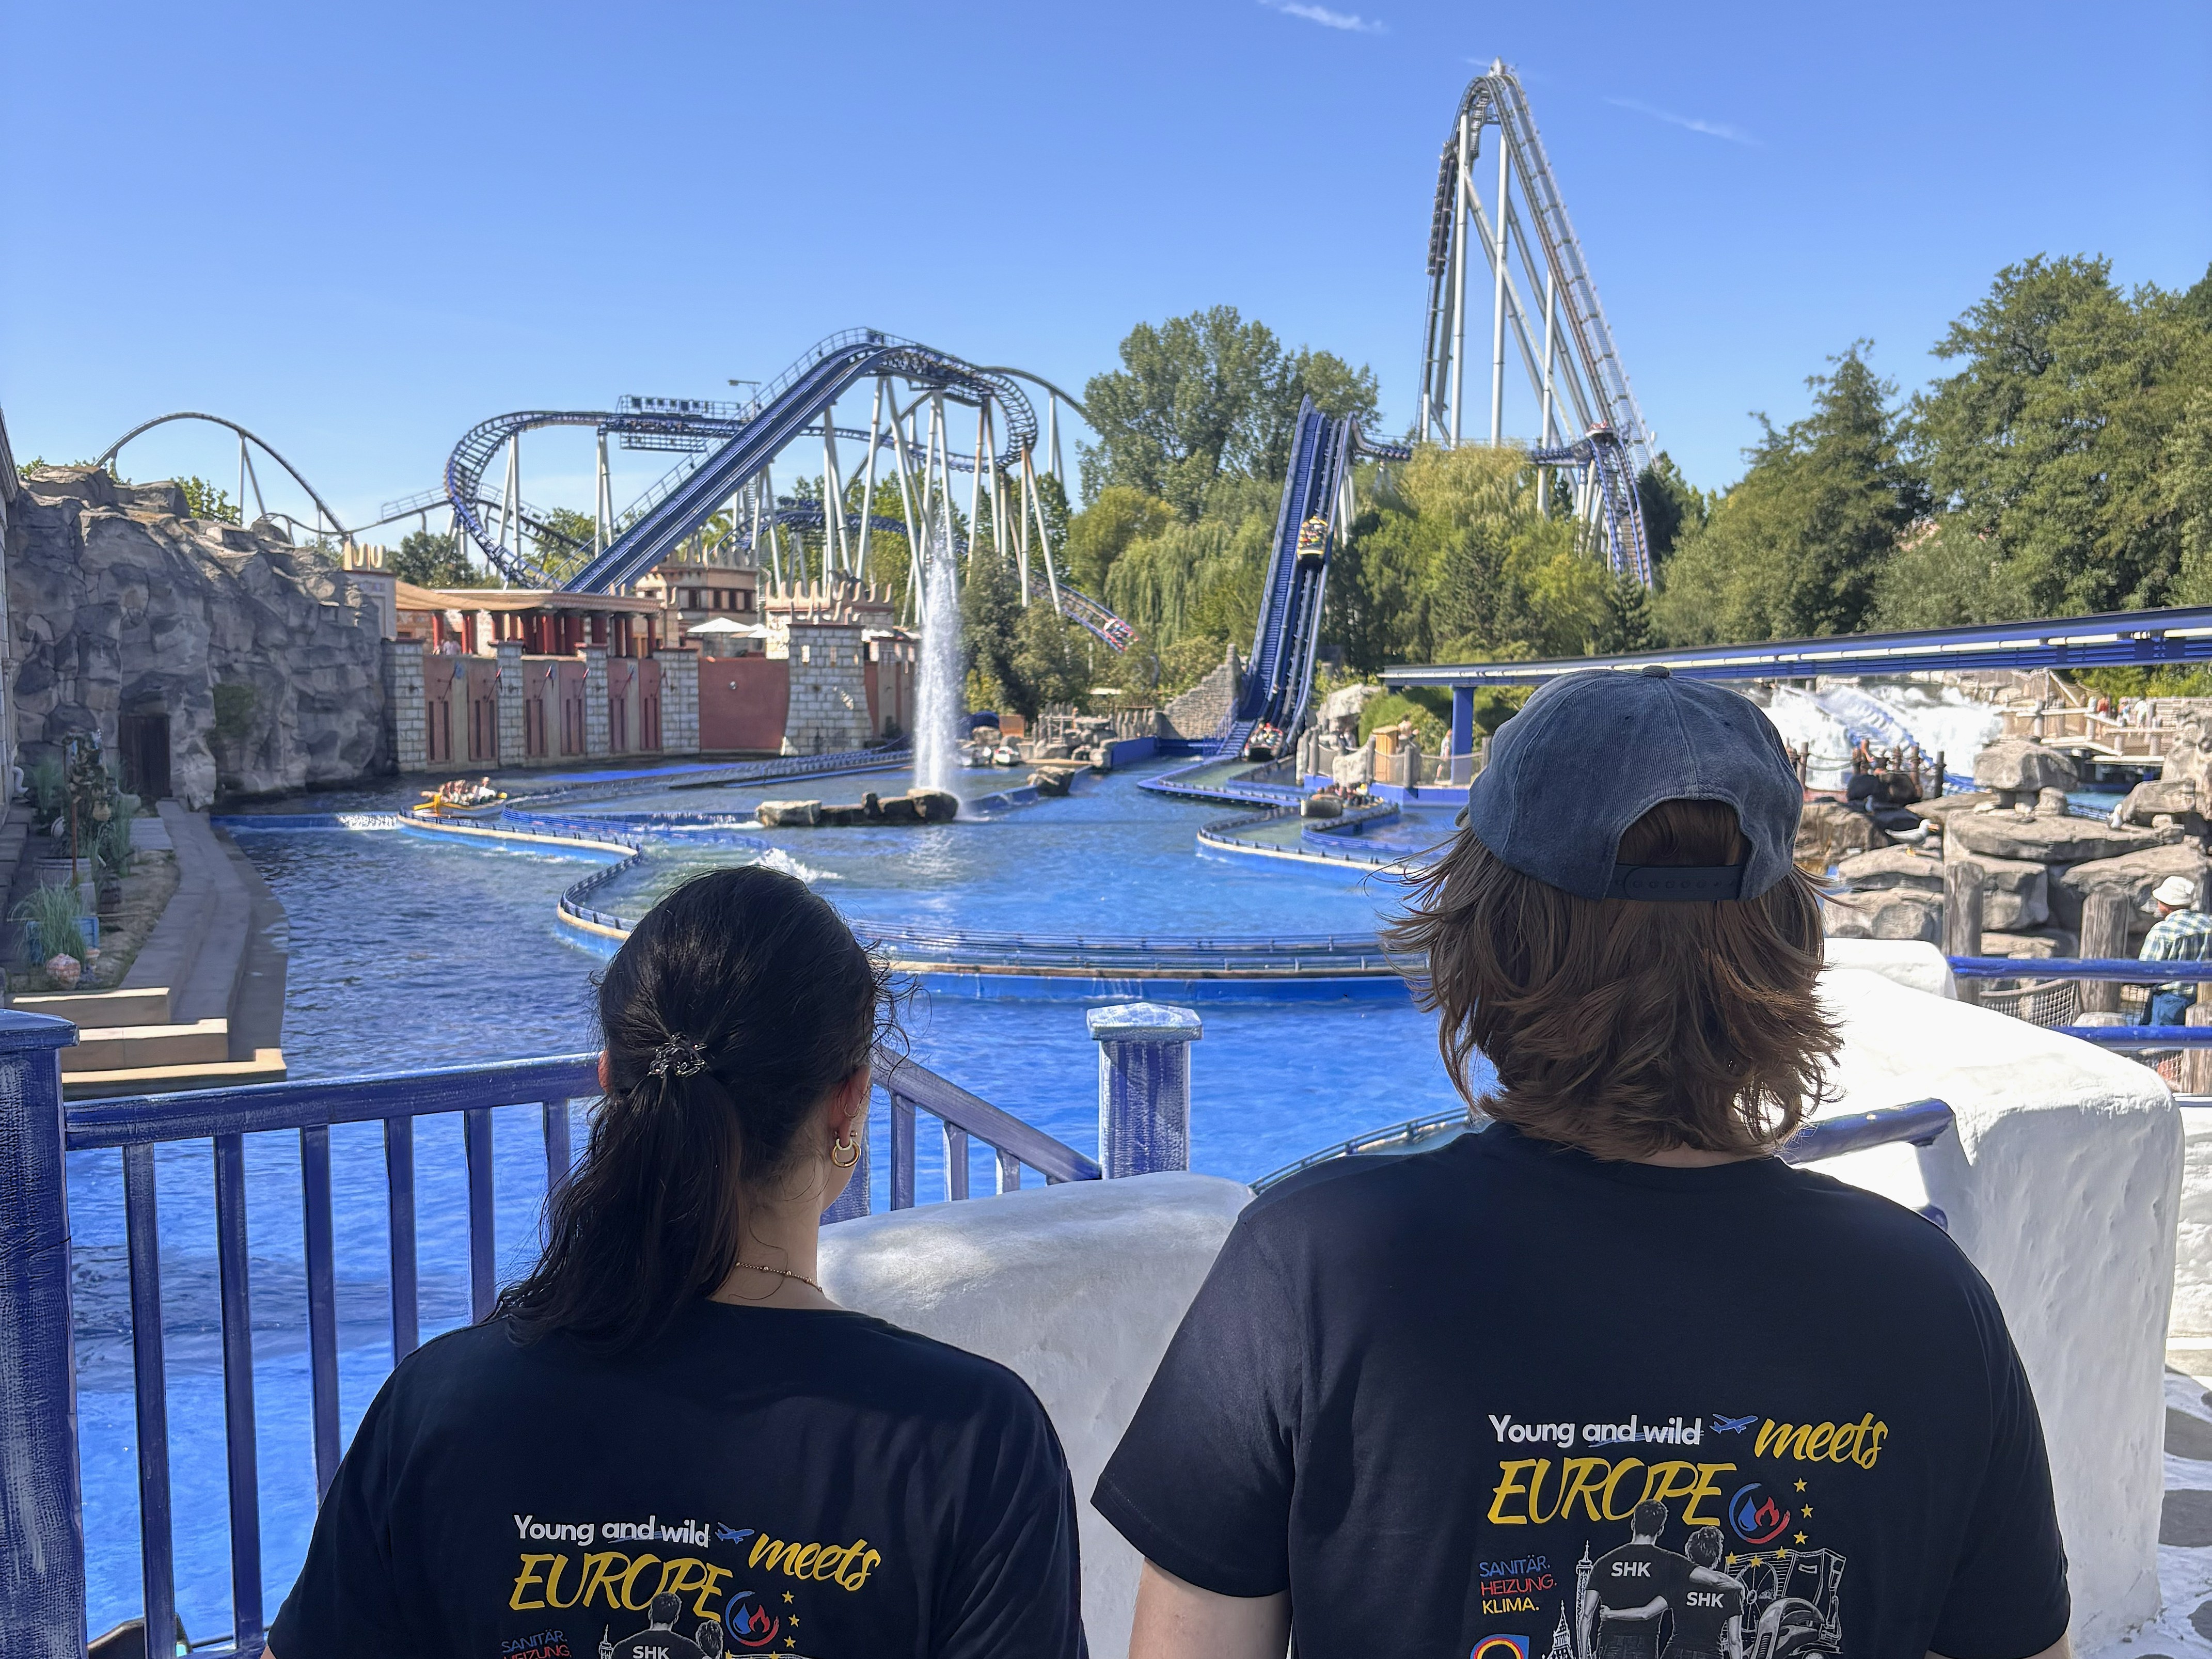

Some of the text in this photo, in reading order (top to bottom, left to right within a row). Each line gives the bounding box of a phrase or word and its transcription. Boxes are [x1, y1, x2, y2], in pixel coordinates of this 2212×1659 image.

[1489, 1413, 1889, 1470] Young and wild meets
[1487, 1457, 1737, 1526] EUROPE
[514, 1515, 881, 1591] Young and wild meets
[1479, 1554, 1550, 1577] SANITÄR.
[1610, 1561, 1651, 1577] SHK
[509, 1552, 733, 1622] EUROPE
[1480, 1574, 1557, 1597] HEIZUNG.
[1482, 1597, 1540, 1615] KLIMA.
[1686, 1591, 1724, 1608] SHK
[501, 1629, 567, 1652] SANITÄR.
[504, 1645, 572, 1659] EIZUNG.
[633, 1646, 670, 1659] SHK
